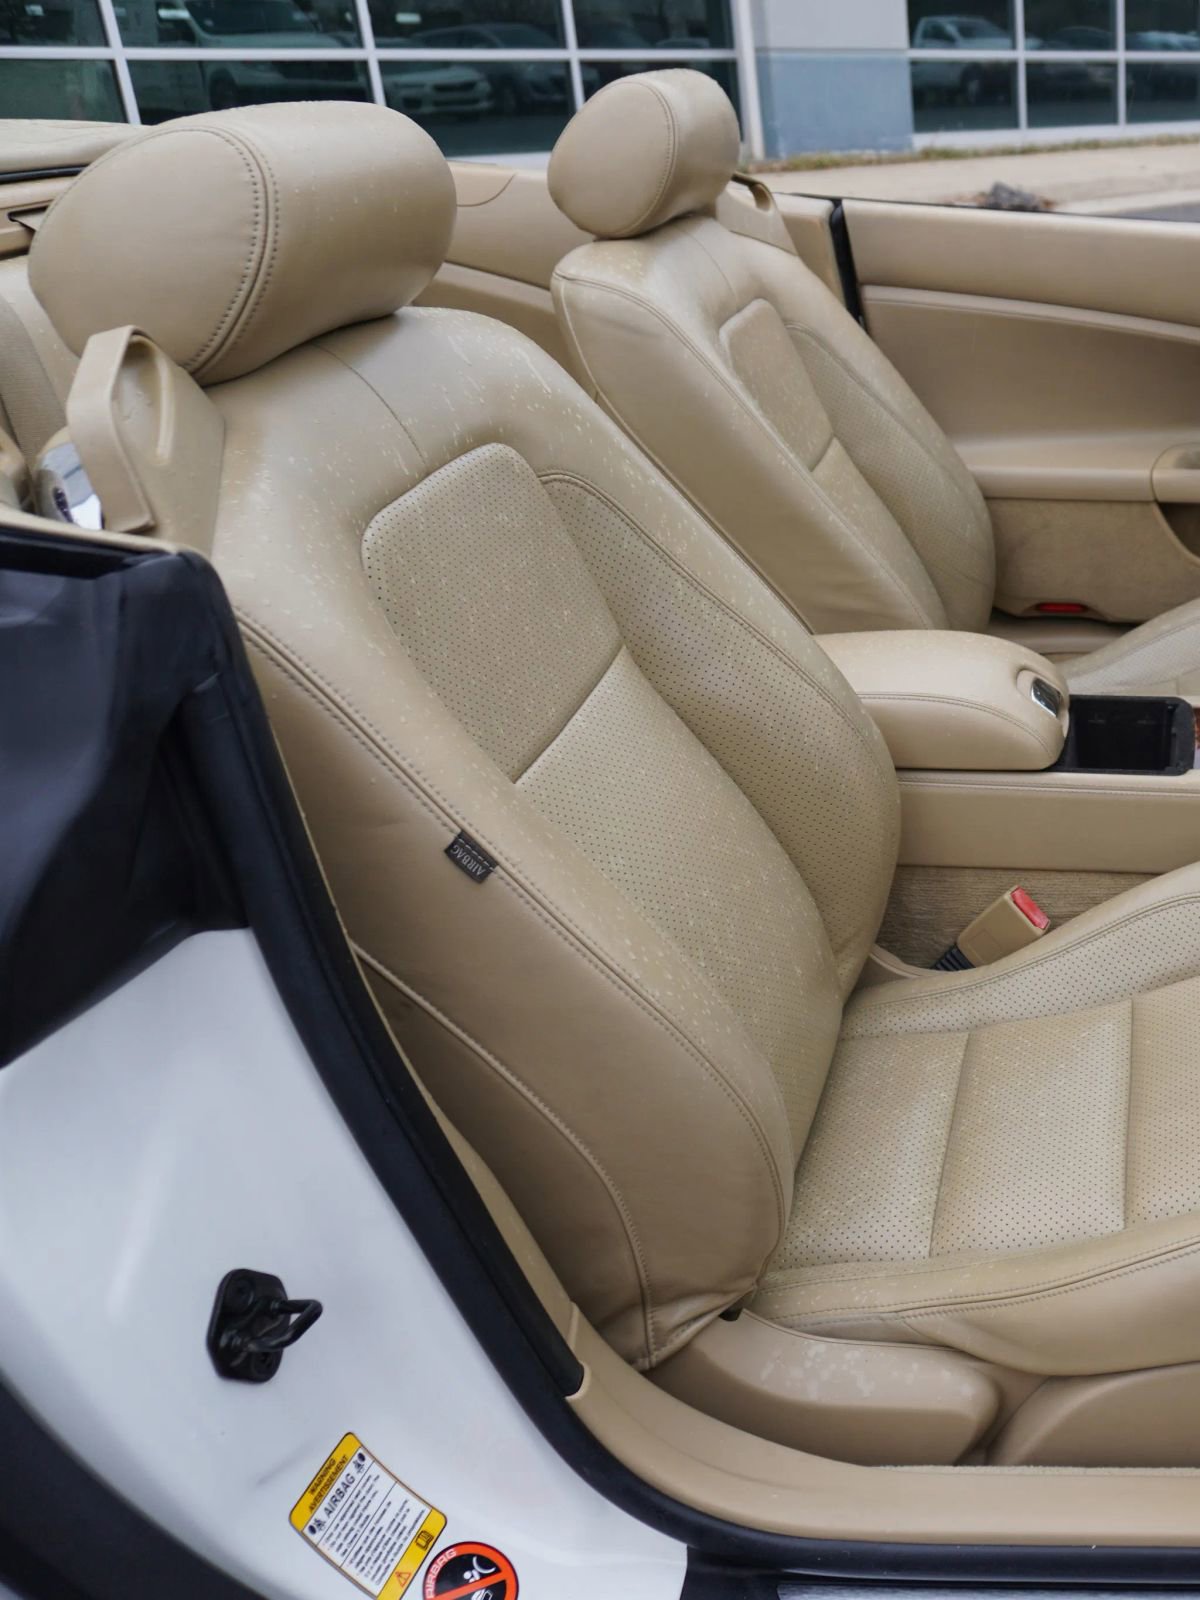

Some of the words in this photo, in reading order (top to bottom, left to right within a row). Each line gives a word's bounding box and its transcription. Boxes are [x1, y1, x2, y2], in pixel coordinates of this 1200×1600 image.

[450, 844, 486, 876] AIRBAG
[323, 1473, 356, 1519] AIRBAG
[424, 1548, 458, 1599] AIRBAG
